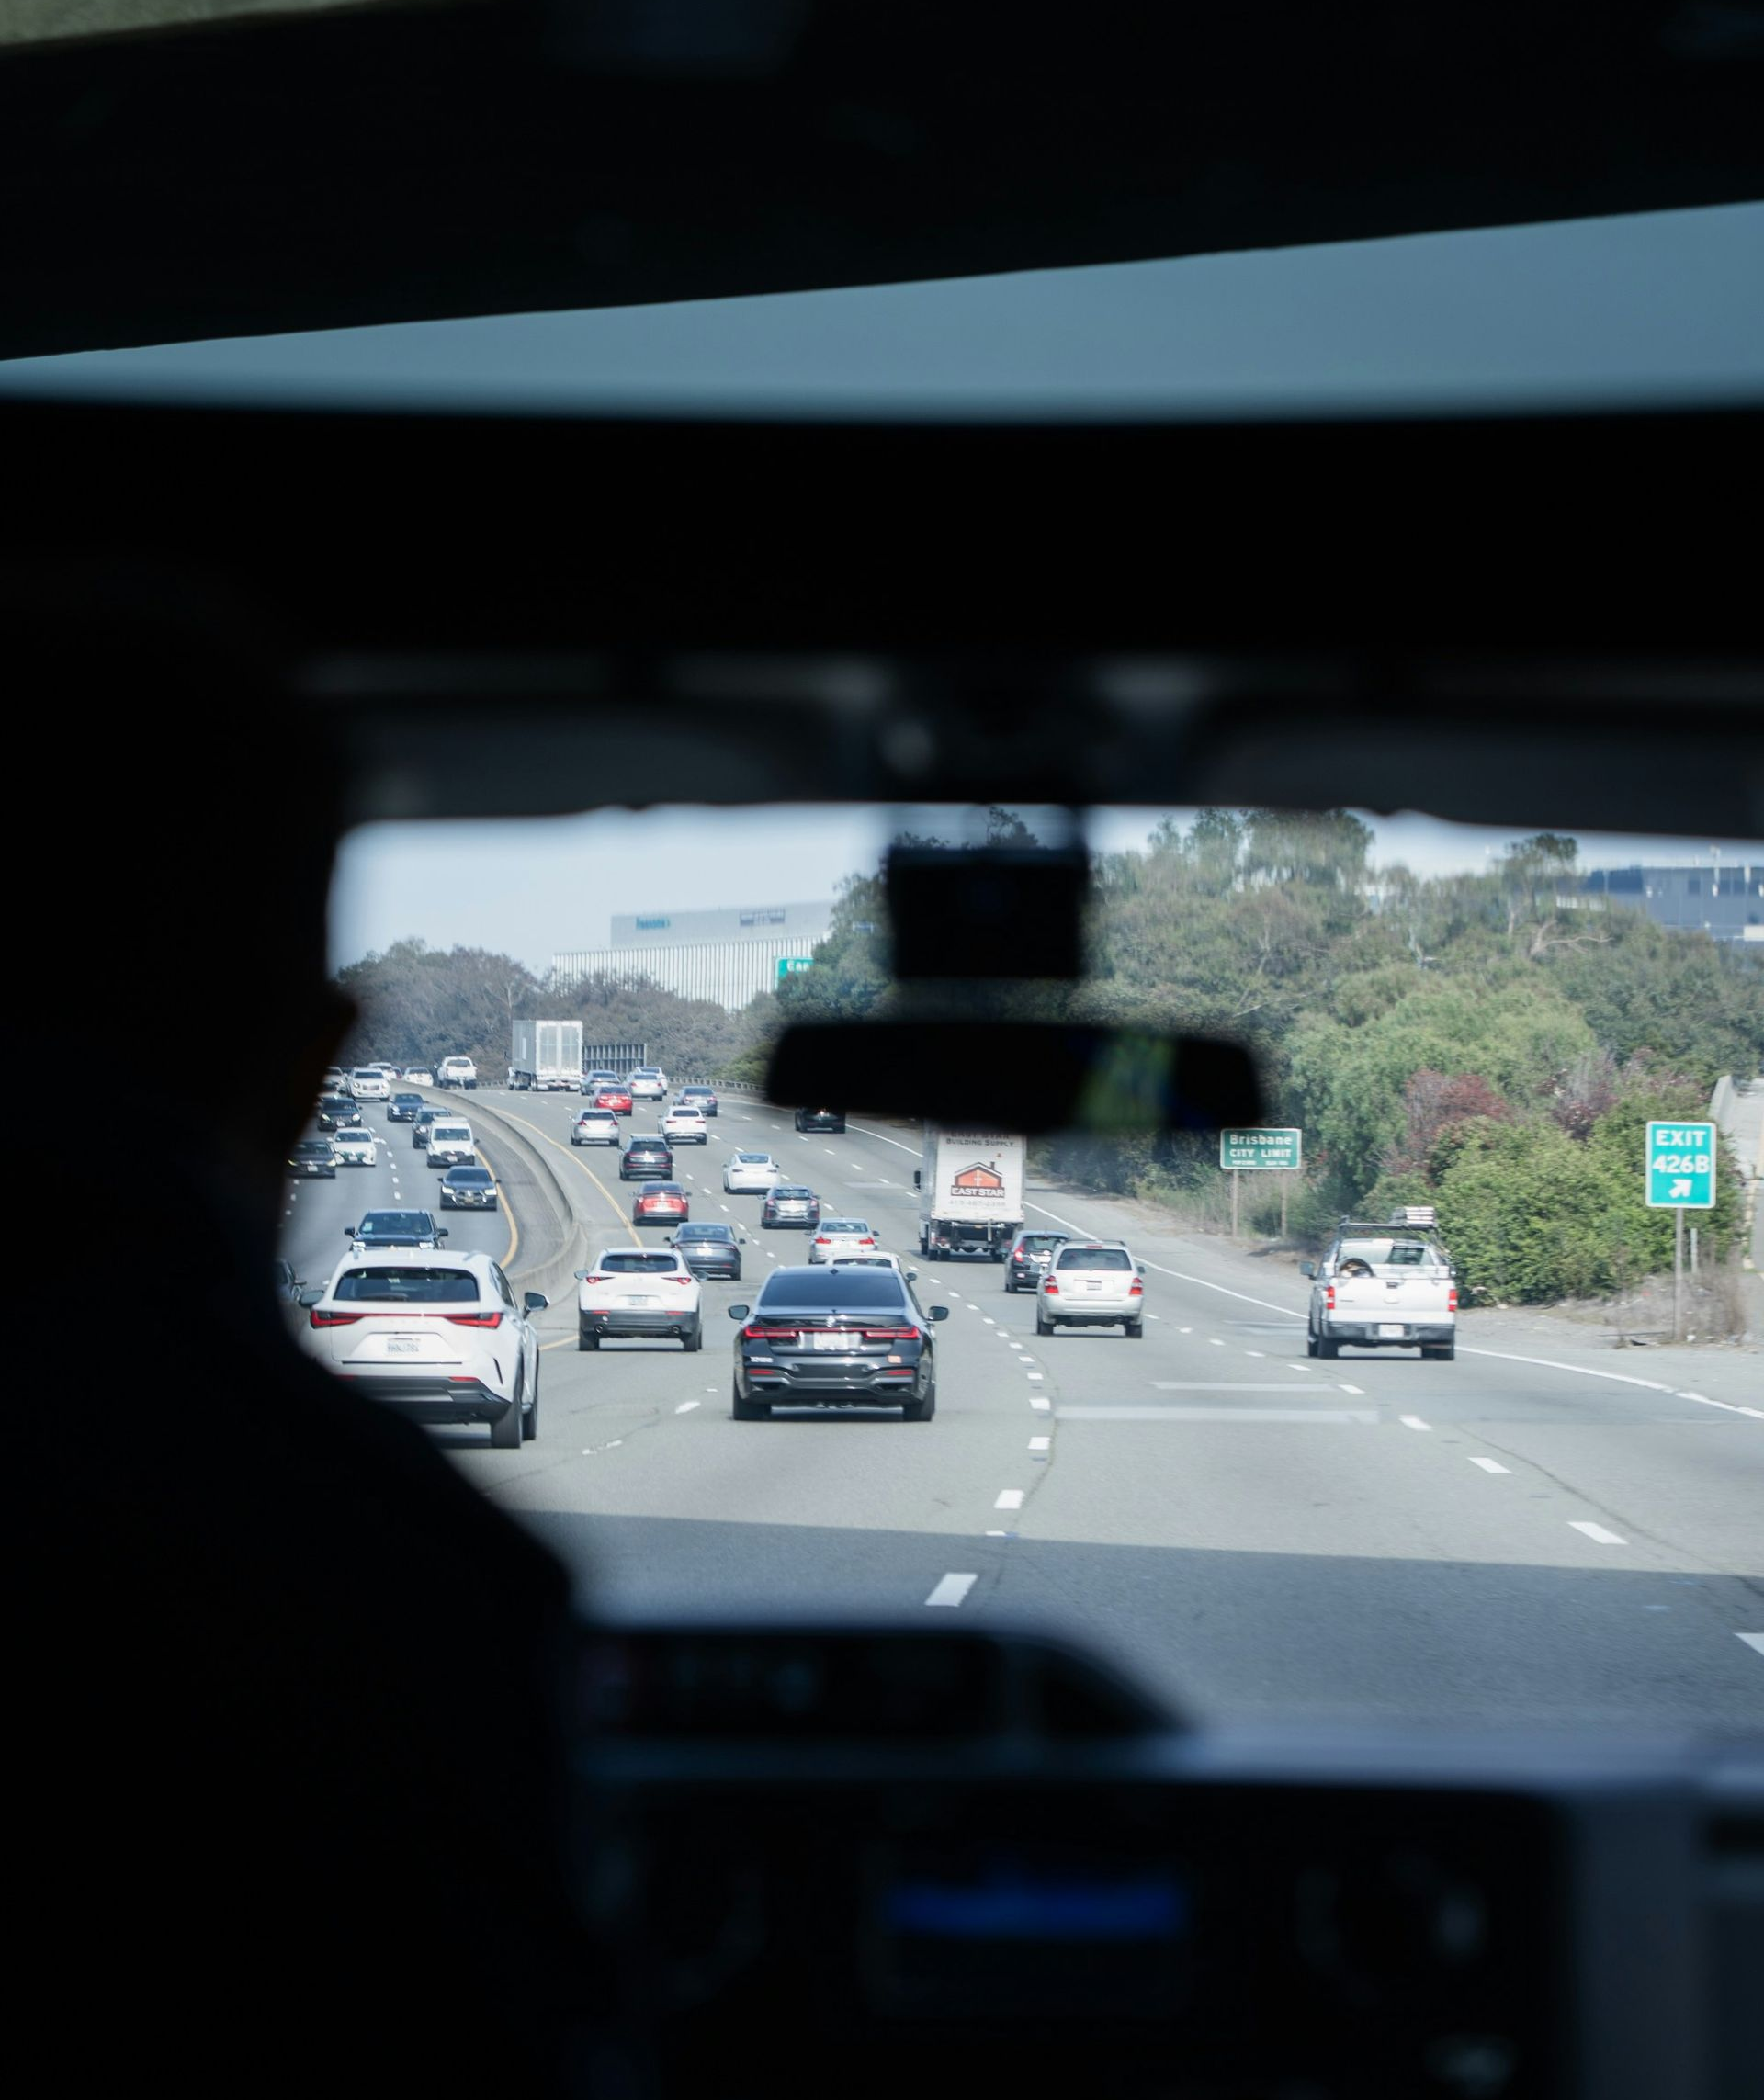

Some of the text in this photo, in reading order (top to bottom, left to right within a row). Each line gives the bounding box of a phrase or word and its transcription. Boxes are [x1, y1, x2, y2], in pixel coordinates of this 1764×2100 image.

[946, 1137, 982, 1146] BUILDING
[1229, 1134, 1293, 1146] Brisbane
[1656, 1130, 1707, 1146] EXIT
[1229, 1148, 1292, 1157] CITY LIMIT
[1653, 1155, 1710, 1174] 426B
[952, 1187, 1004, 1197] EAST STAR
